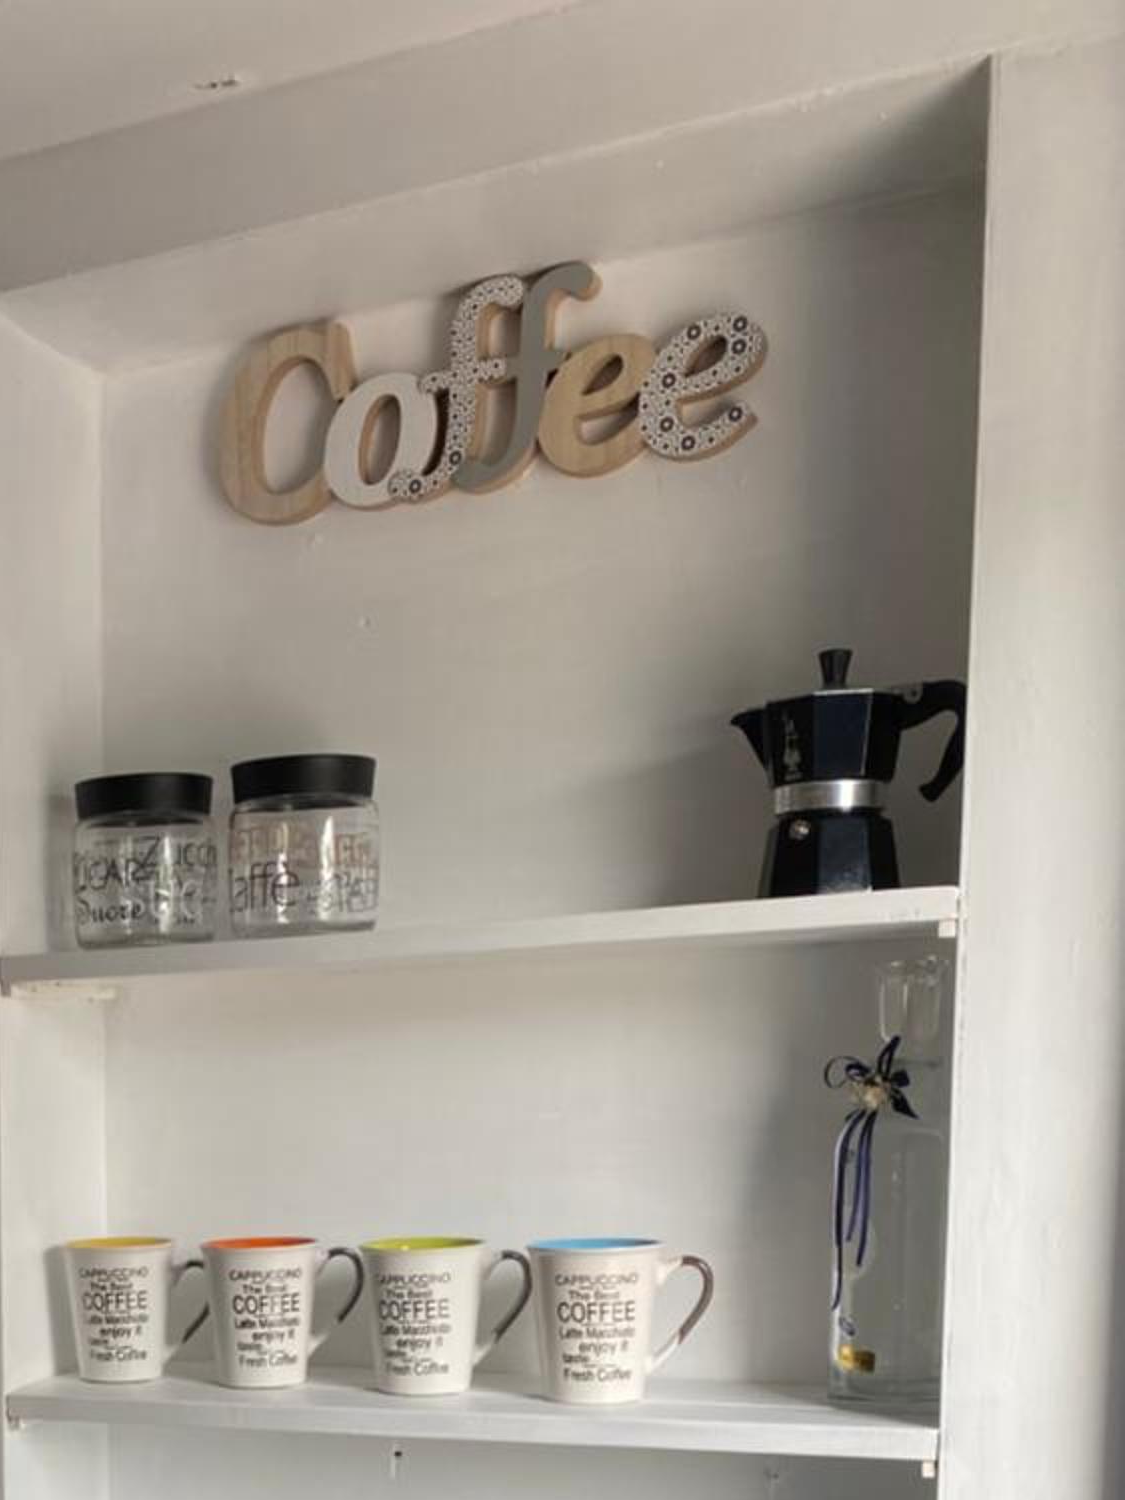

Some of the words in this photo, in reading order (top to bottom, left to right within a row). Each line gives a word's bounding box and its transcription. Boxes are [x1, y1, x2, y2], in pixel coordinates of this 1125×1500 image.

[221, 260, 767, 526] Coffee
[554, 1272, 639, 1286] CAPPUCCINO
[82, 1290, 148, 1310] COFFEE
[232, 1293, 300, 1315] COFFEE
[379, 1298, 451, 1320] COFFEE
[556, 1299, 636, 1323] COFFEE
[578, 1342, 617, 1356] enjoy
